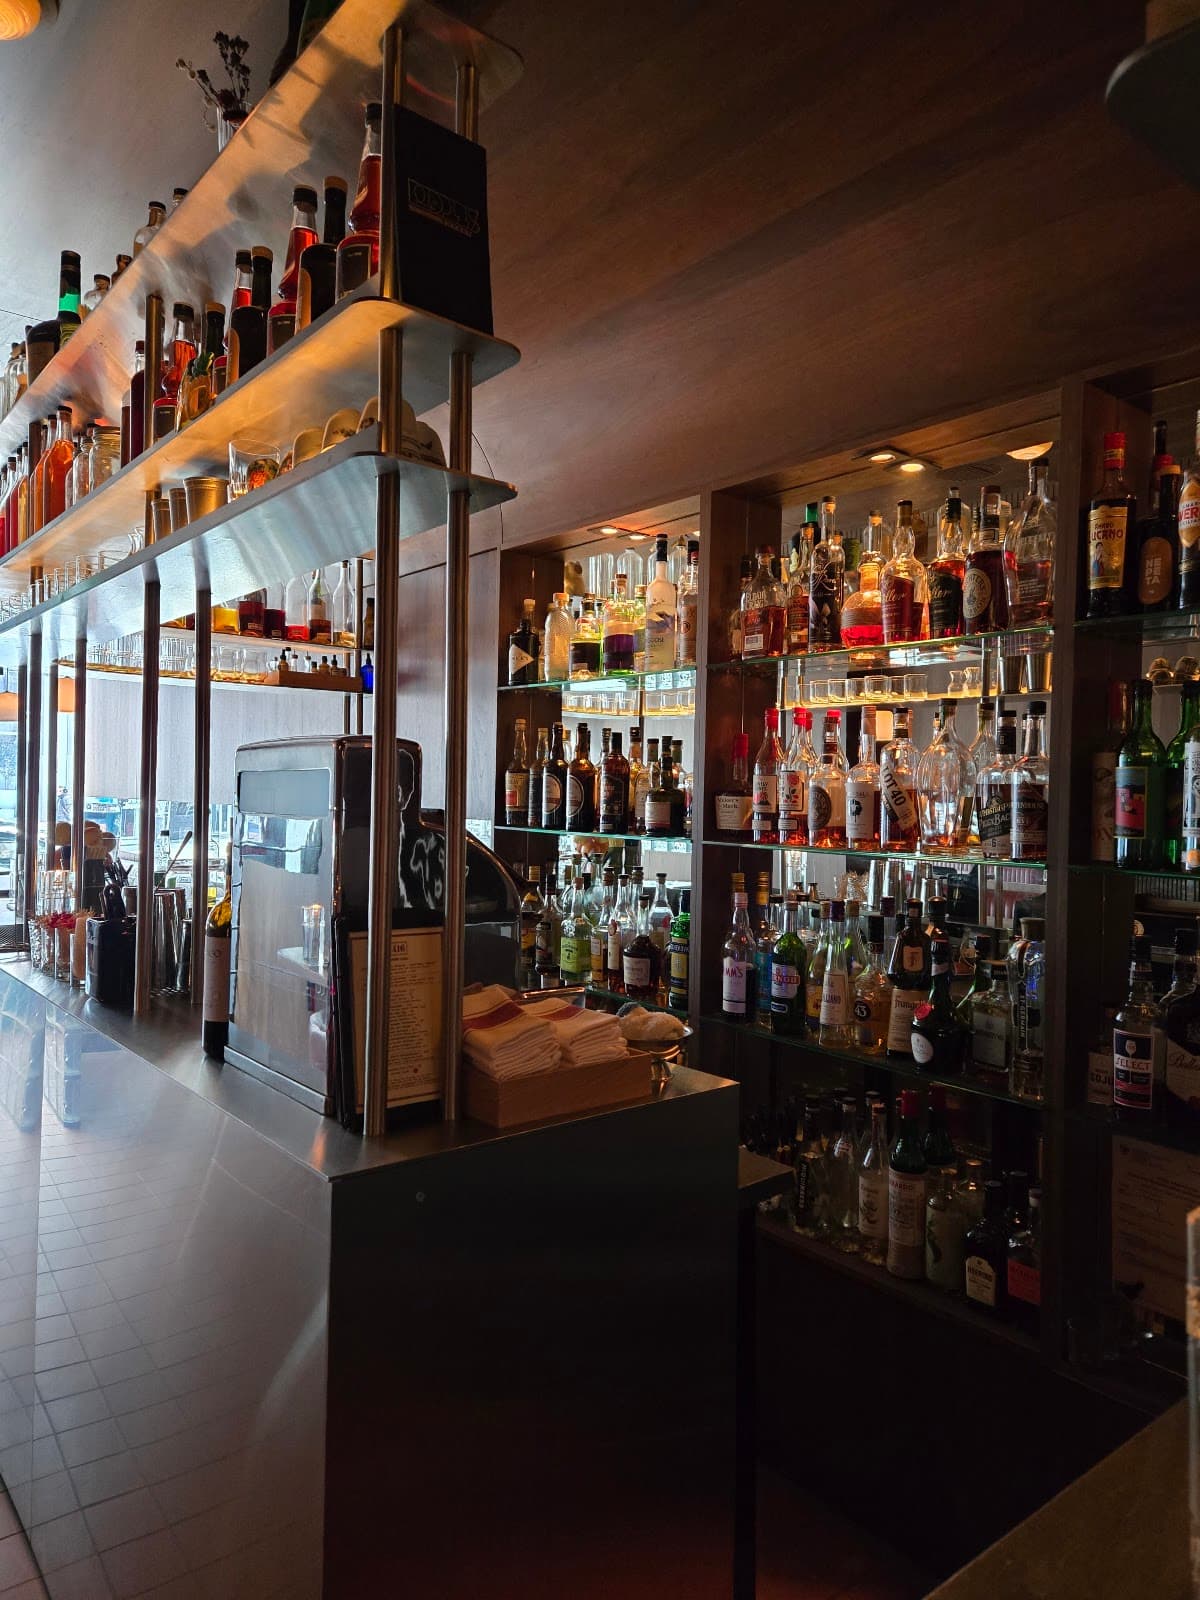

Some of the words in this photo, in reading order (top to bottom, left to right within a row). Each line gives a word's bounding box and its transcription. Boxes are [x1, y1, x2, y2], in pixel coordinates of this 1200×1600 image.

[1146, 558, 1161, 568] NE
[1145, 568, 1160, 576] PE
[1145, 576, 1160, 584] TA
[883, 766, 898, 789] LOT
[890, 790, 907, 807] 40
[855, 1004, 867, 1017] 43
[1115, 1057, 1151, 1071] SELECT
